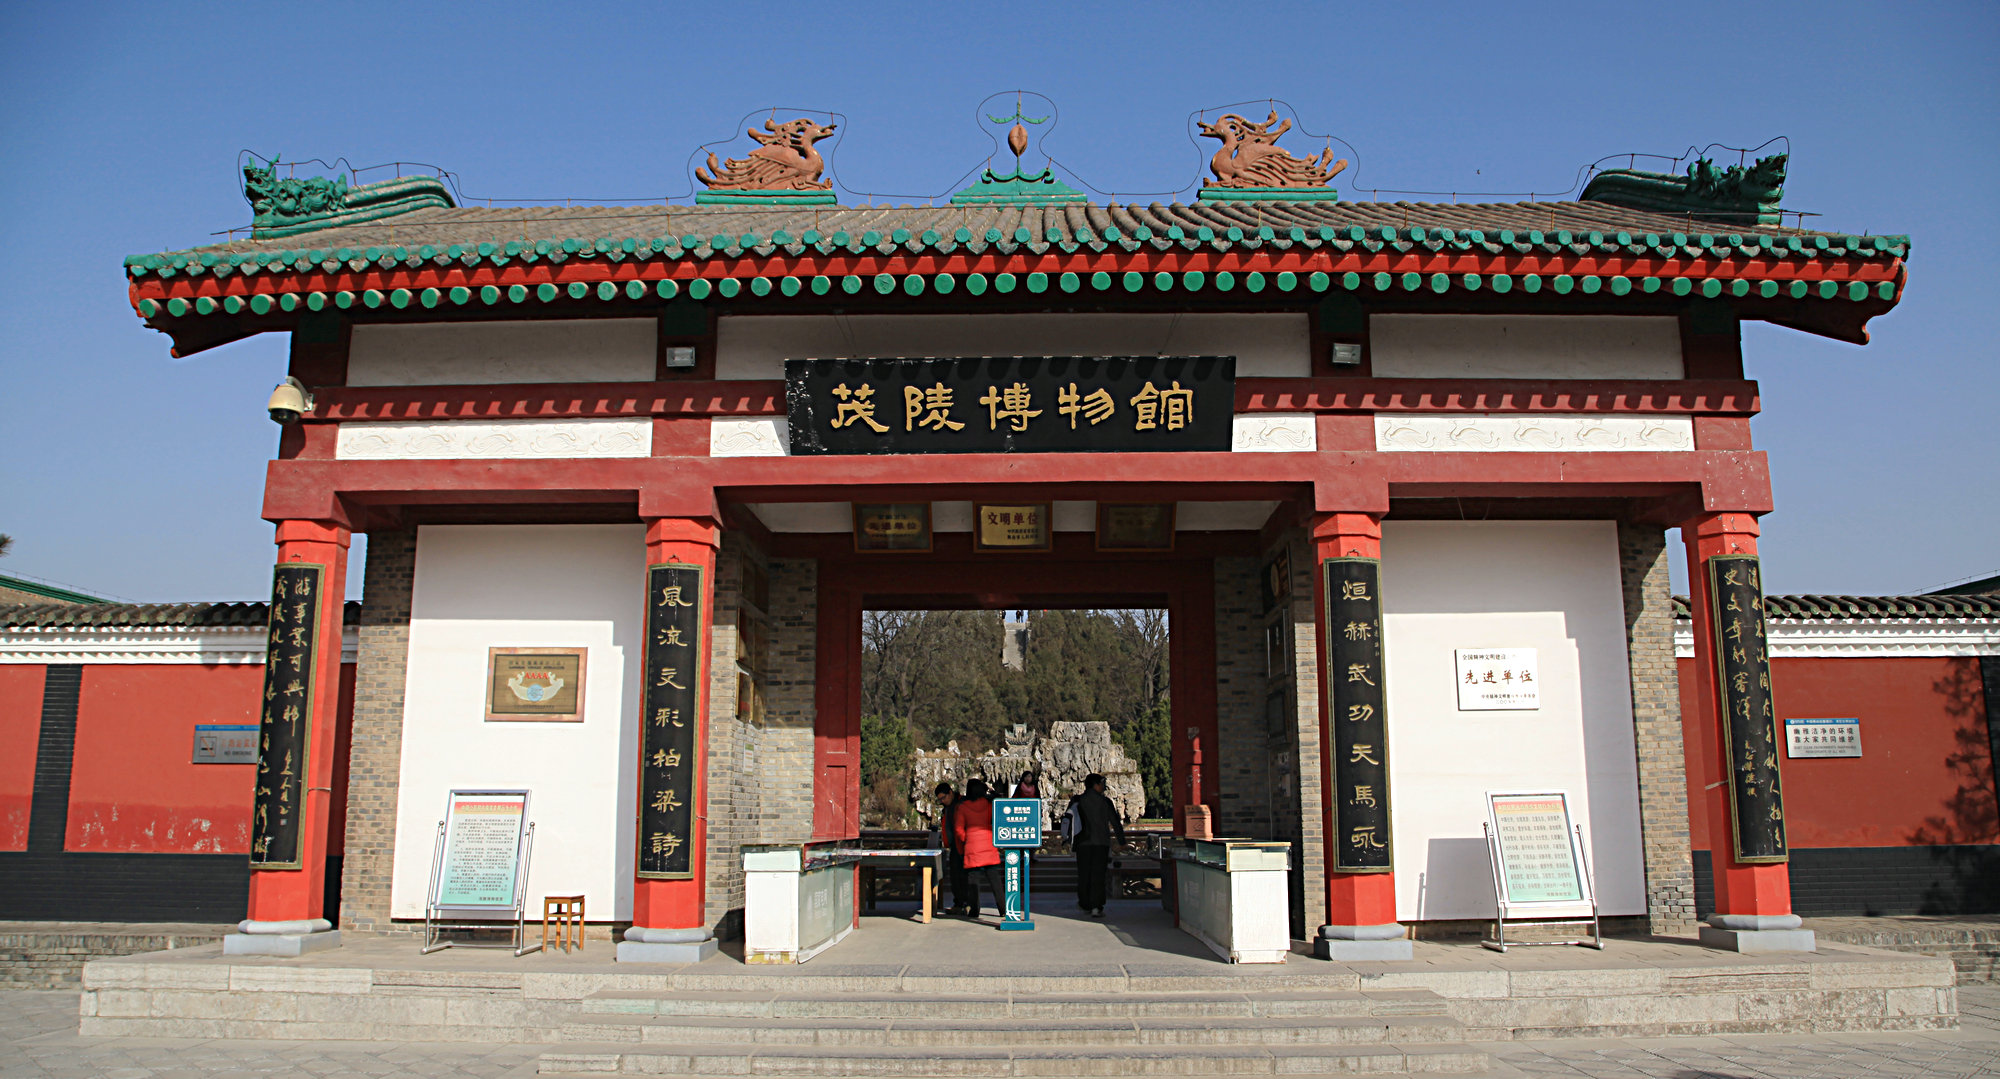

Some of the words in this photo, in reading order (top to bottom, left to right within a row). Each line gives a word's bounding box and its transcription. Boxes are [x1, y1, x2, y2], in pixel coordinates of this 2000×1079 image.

[988, 512, 1040, 525] 文明单位
[1464, 669, 1533, 685] 先进单位
